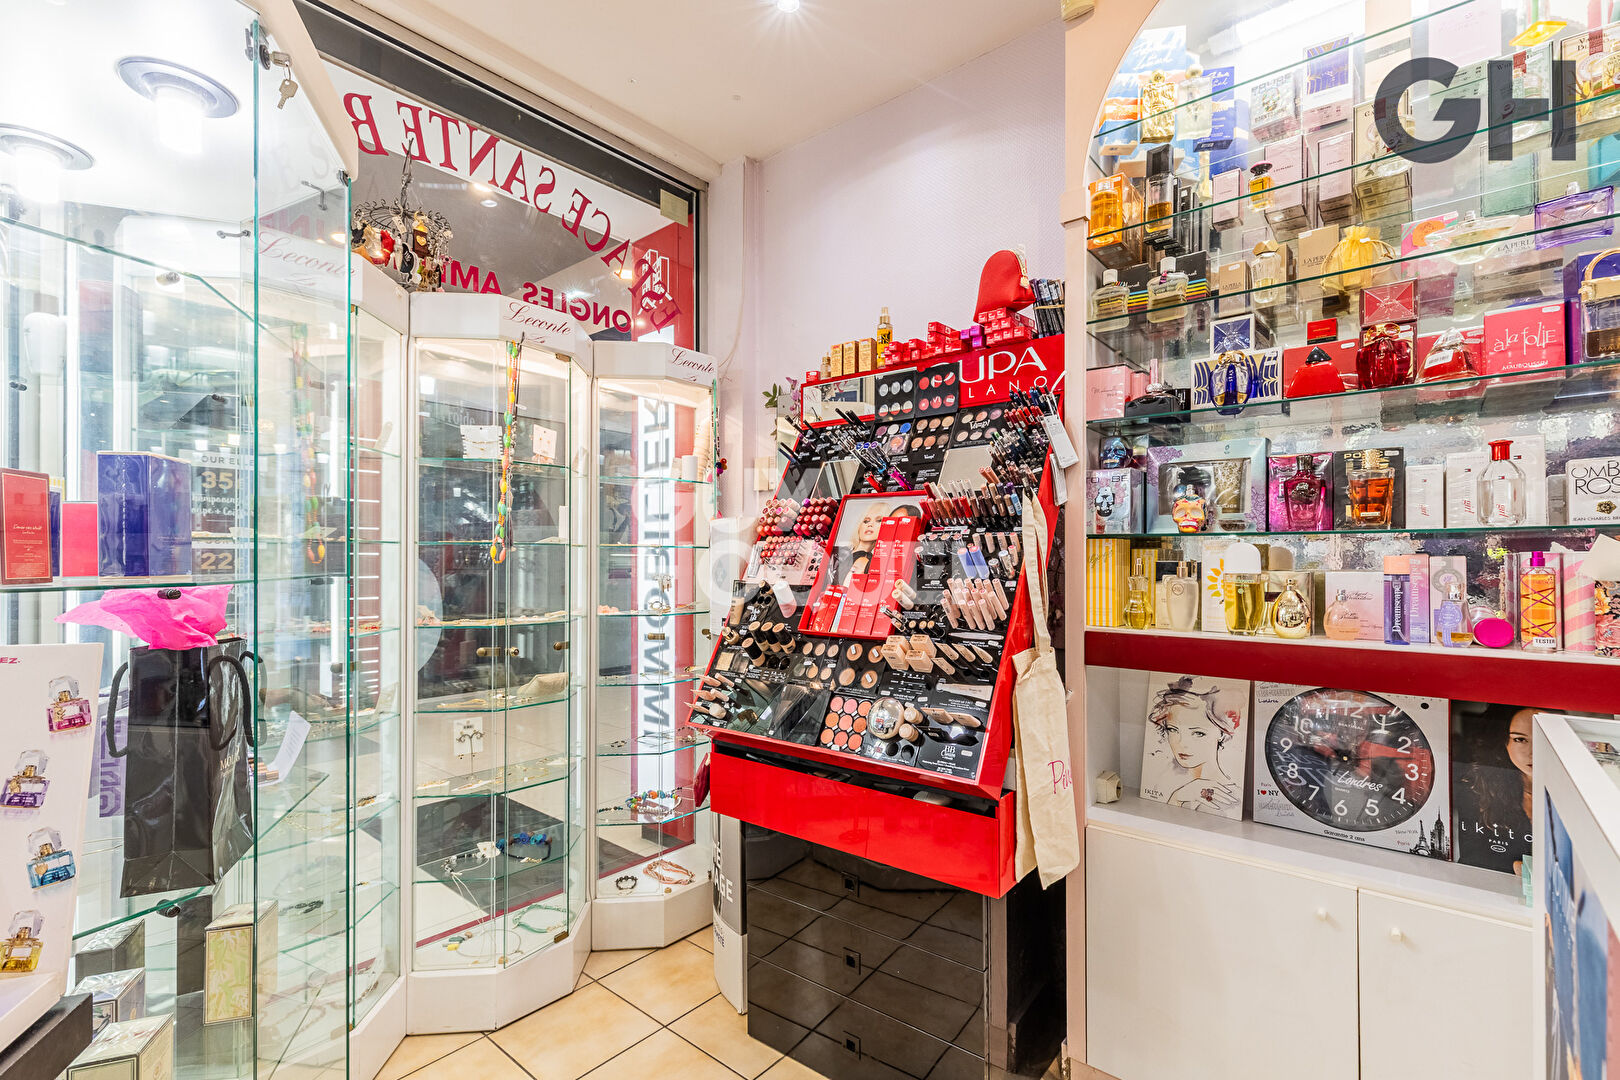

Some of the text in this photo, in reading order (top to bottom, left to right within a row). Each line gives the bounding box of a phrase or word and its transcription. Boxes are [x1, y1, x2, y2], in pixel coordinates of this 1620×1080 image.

[507, 301, 572, 337] Leconte
[671, 348, 715, 374] Leconte
[201, 471, 234, 489] 35
[200, 552, 233, 570] 22
[1392, 582, 1404, 633] Dreamscape
[1280, 738, 1293, 753] 9
[1396, 736, 1412, 754] 2
[1287, 762, 1298, 779] 8
[1404, 763, 1419, 781] 3
[1337, 770, 1384, 792] Londres
[1308, 784, 1320, 801] 7
[1391, 787, 1407, 805] 4
[1333, 799, 1348, 816] 6
[1364, 799, 1380, 817] 5
